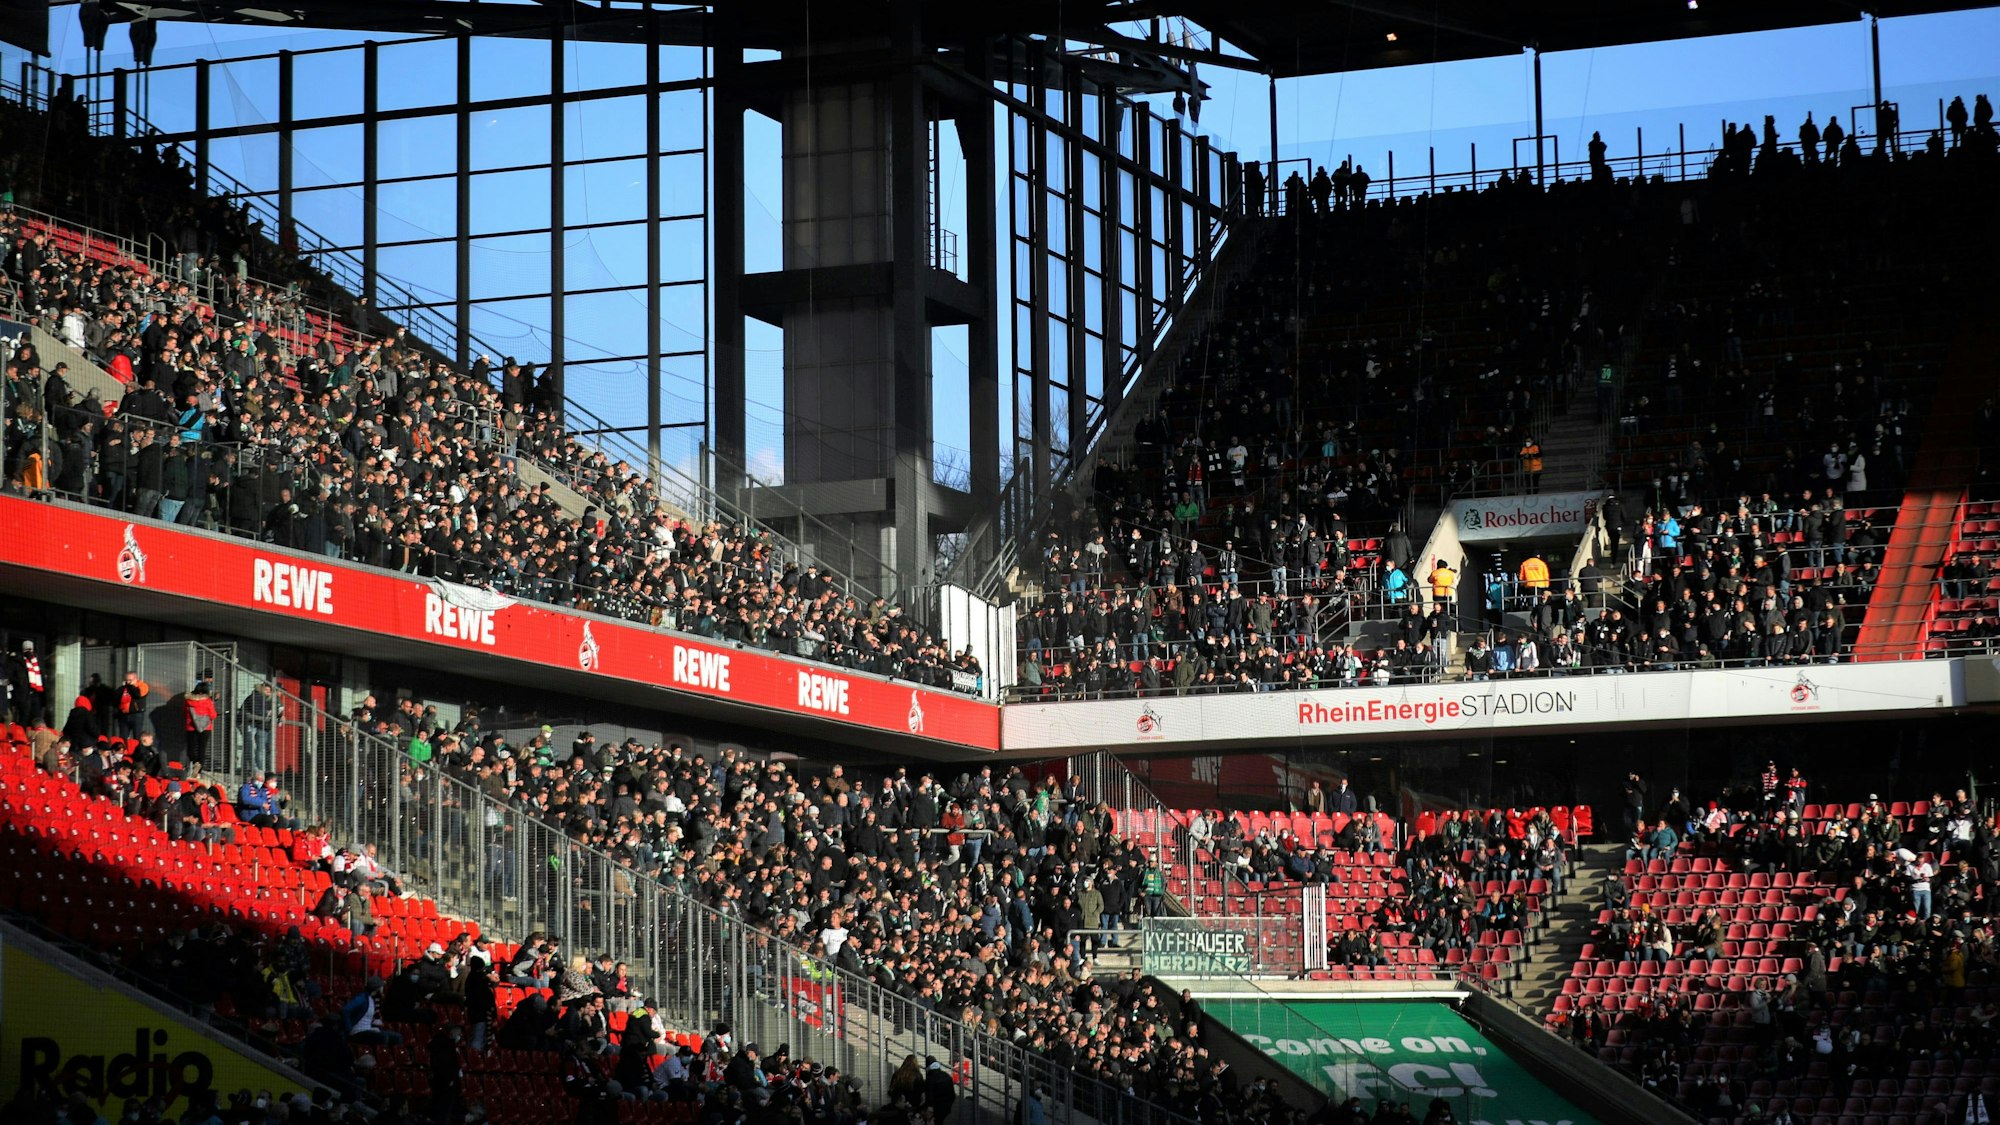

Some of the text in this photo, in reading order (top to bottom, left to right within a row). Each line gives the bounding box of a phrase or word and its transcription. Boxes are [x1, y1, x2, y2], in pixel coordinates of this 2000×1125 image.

[1485, 506, 1580, 528] Rosbacher
[253, 558, 333, 614] REWE
[425, 593, 496, 645] REWE
[673, 645, 730, 691] REWE
[798, 672, 849, 714] REWE
[1299, 691, 1573, 723] RheinEnergieSTADION
[21, 1028, 213, 1097] Radio
